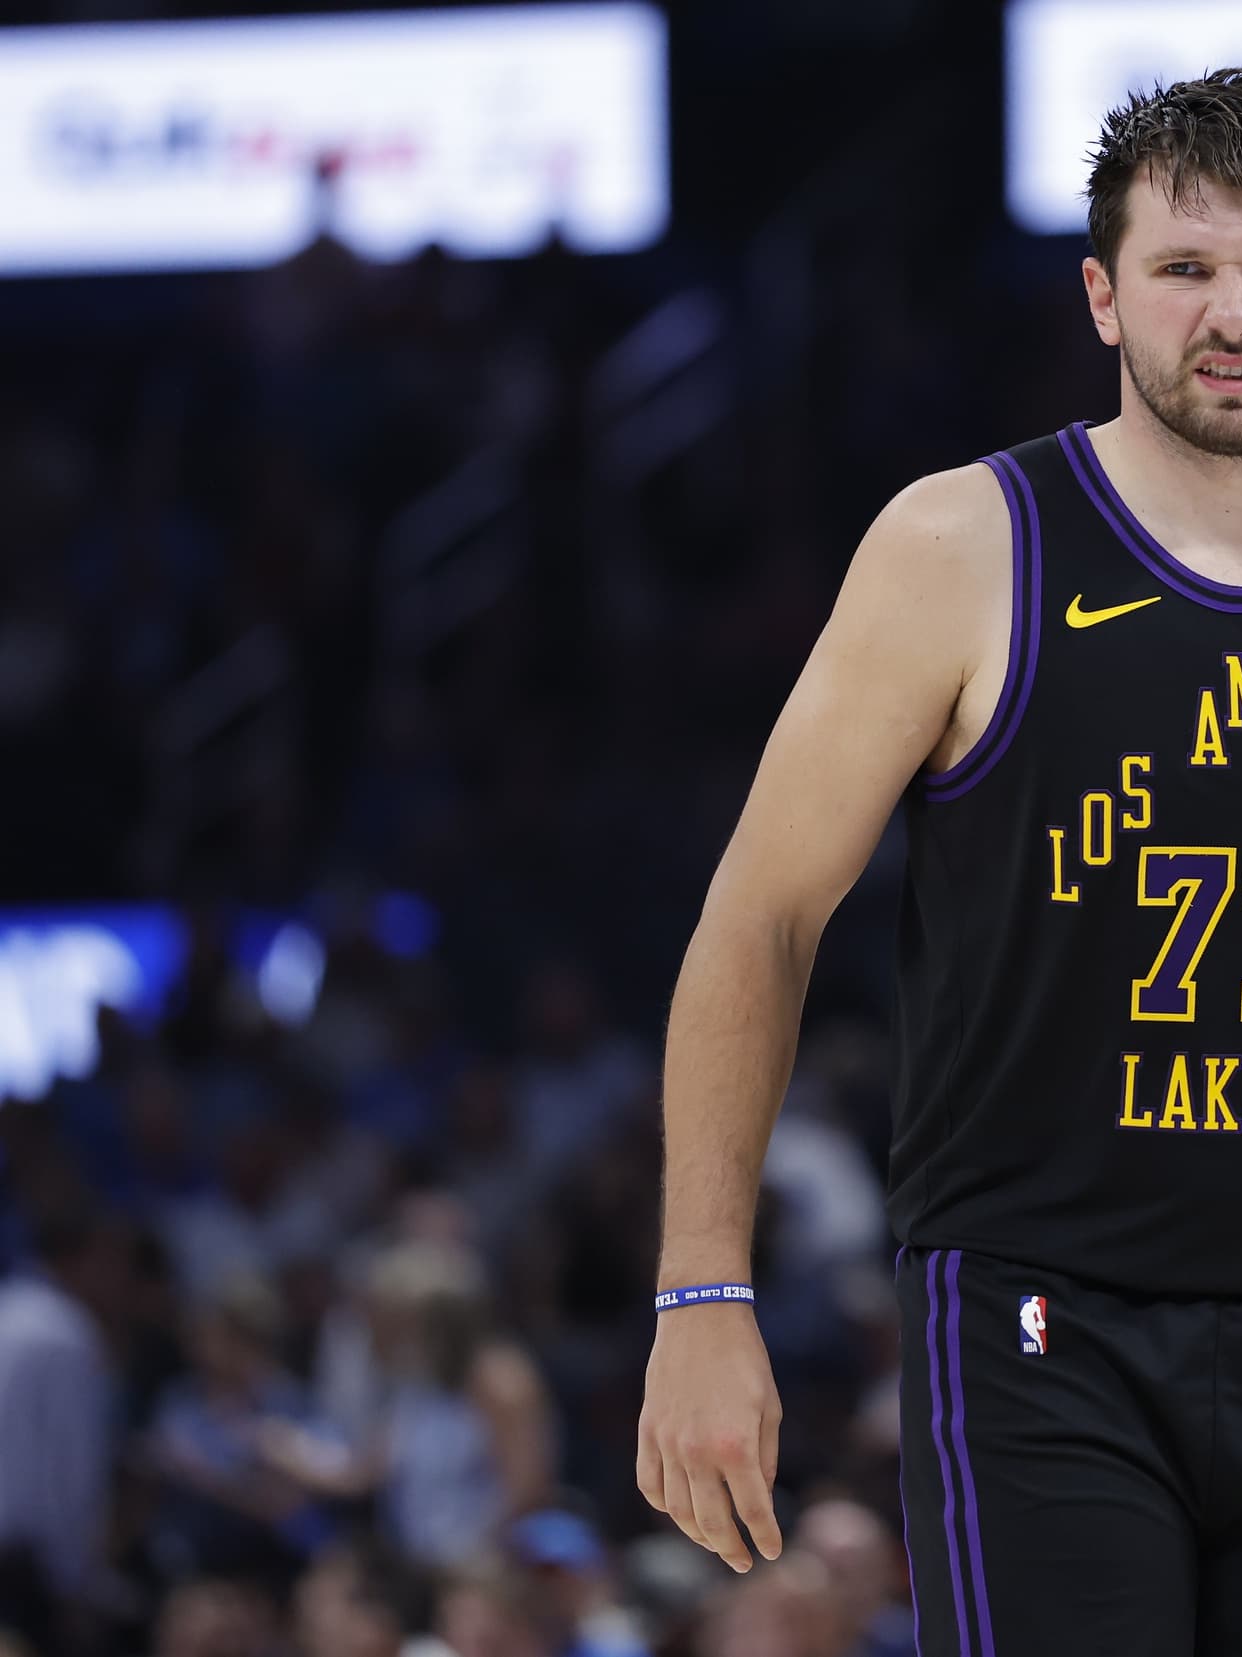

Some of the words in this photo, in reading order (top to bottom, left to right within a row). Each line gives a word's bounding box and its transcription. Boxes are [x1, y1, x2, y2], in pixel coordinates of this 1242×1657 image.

[1047, 754, 1153, 903] LOS
[700, 1288, 721, 1297] CLUB
[1023, 1341, 1038, 1353] NBA
